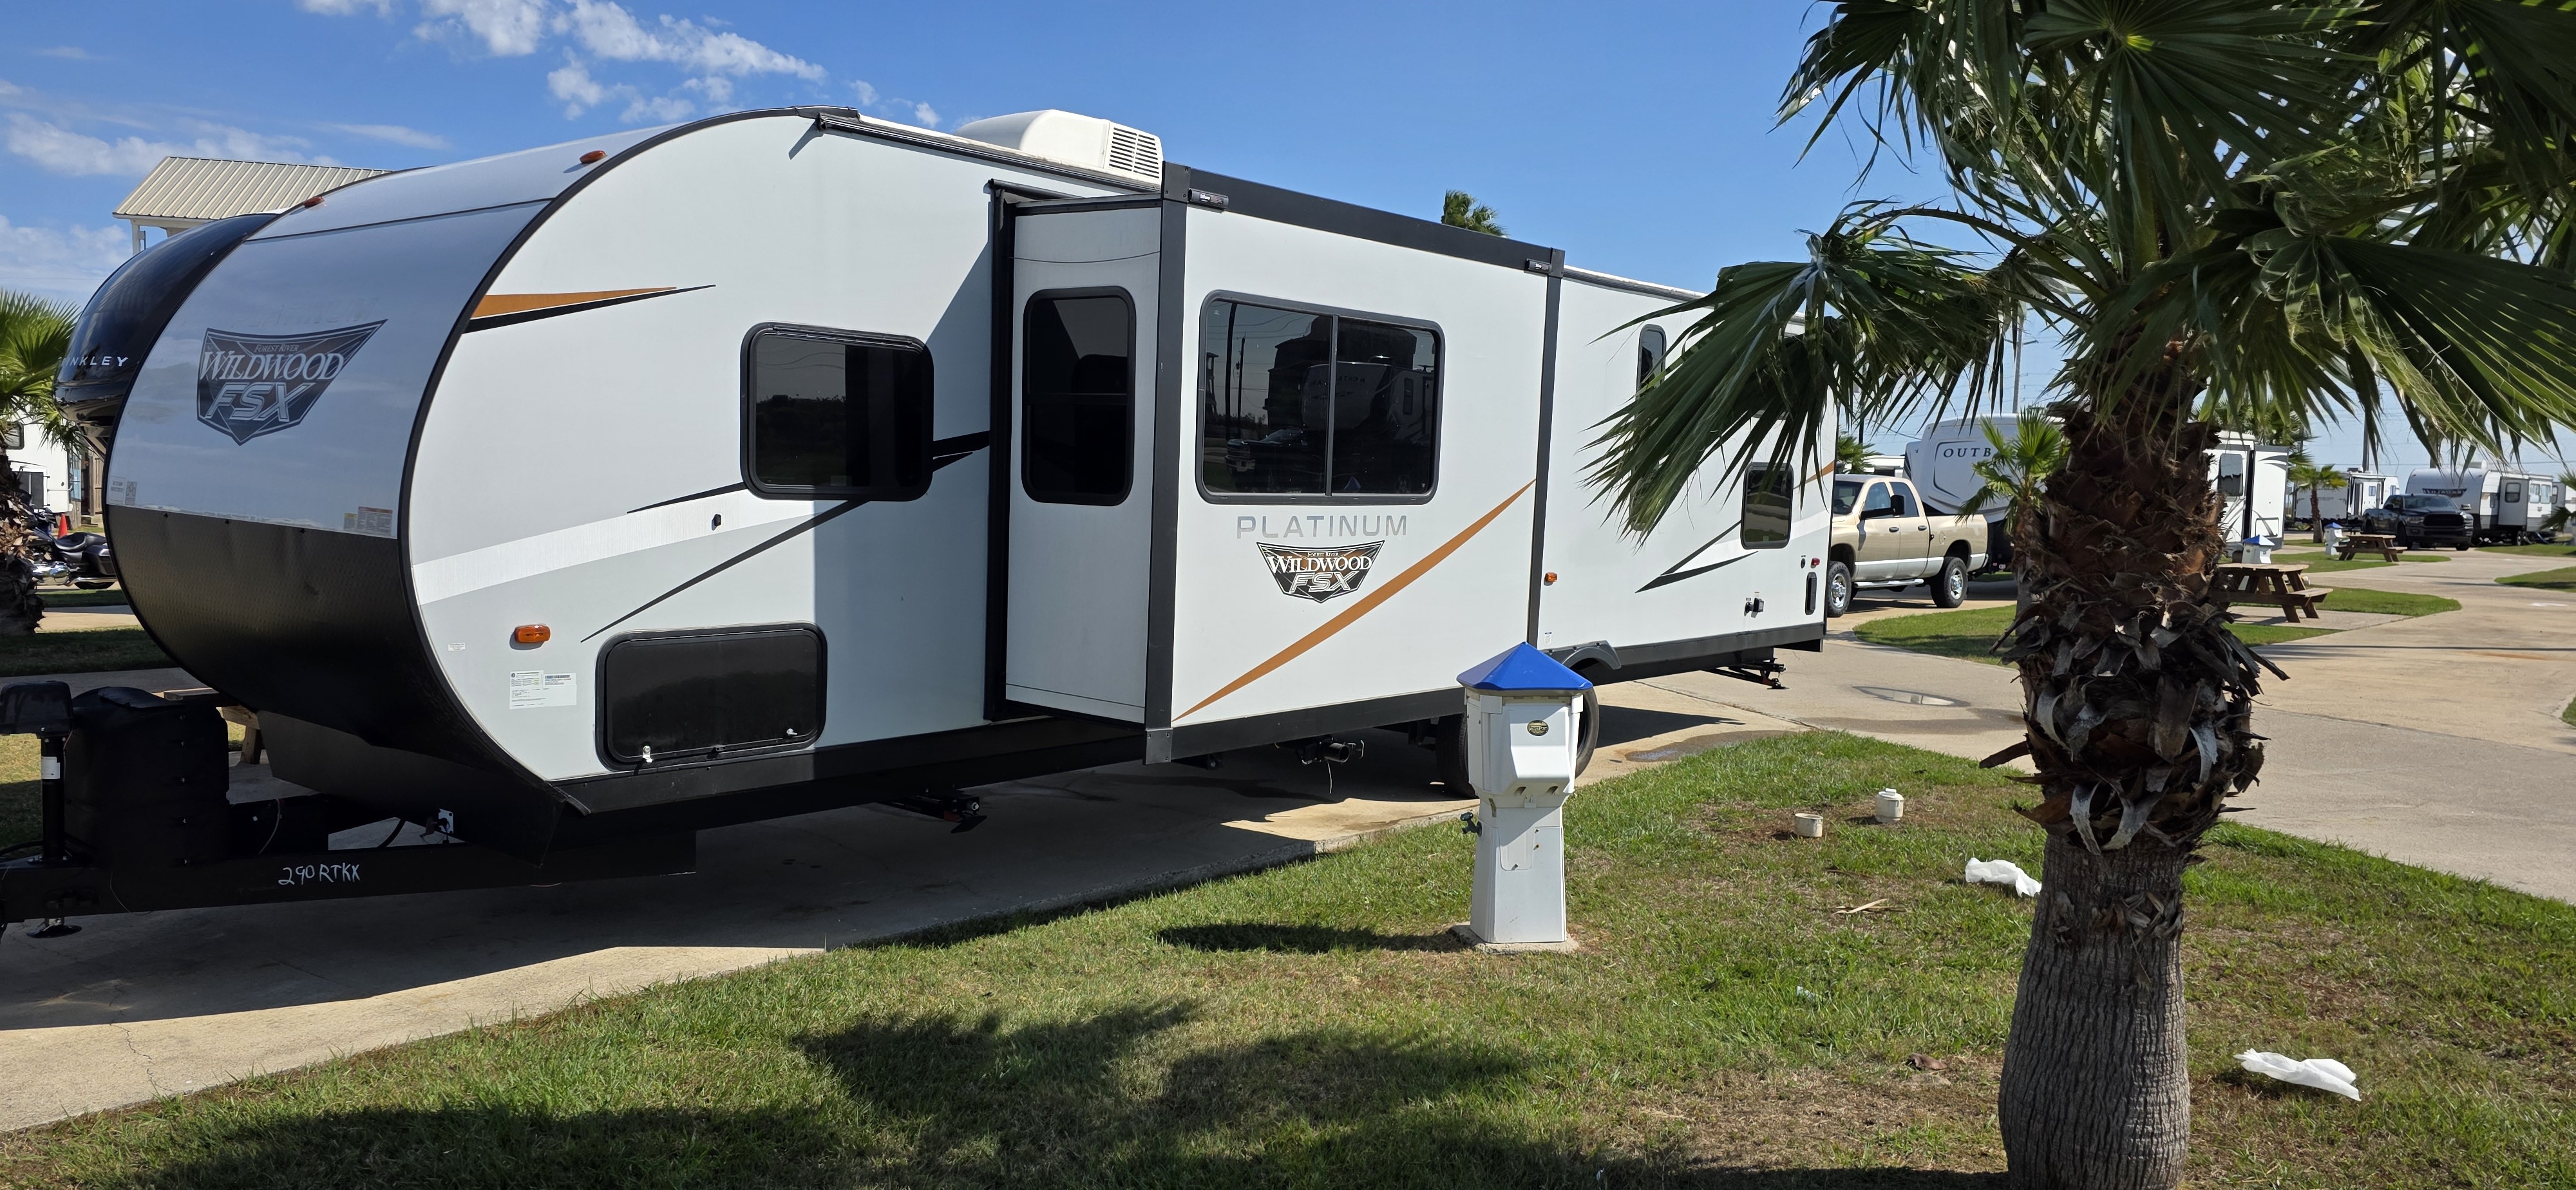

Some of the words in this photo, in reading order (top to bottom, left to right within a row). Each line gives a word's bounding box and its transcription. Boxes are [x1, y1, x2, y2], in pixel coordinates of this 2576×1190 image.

[254, 344, 279, 353] FOREST
[278, 343, 299, 352] RIVER
[200, 350, 344, 381] WILDWOOD
[205, 382, 316, 422] FSX
[1943, 448, 1992, 458] OUTB
[1236, 515, 1407, 539] PLATINUM
[1267, 556, 1372, 573] WILDWOOD
[1289, 571, 1360, 593] FSX
